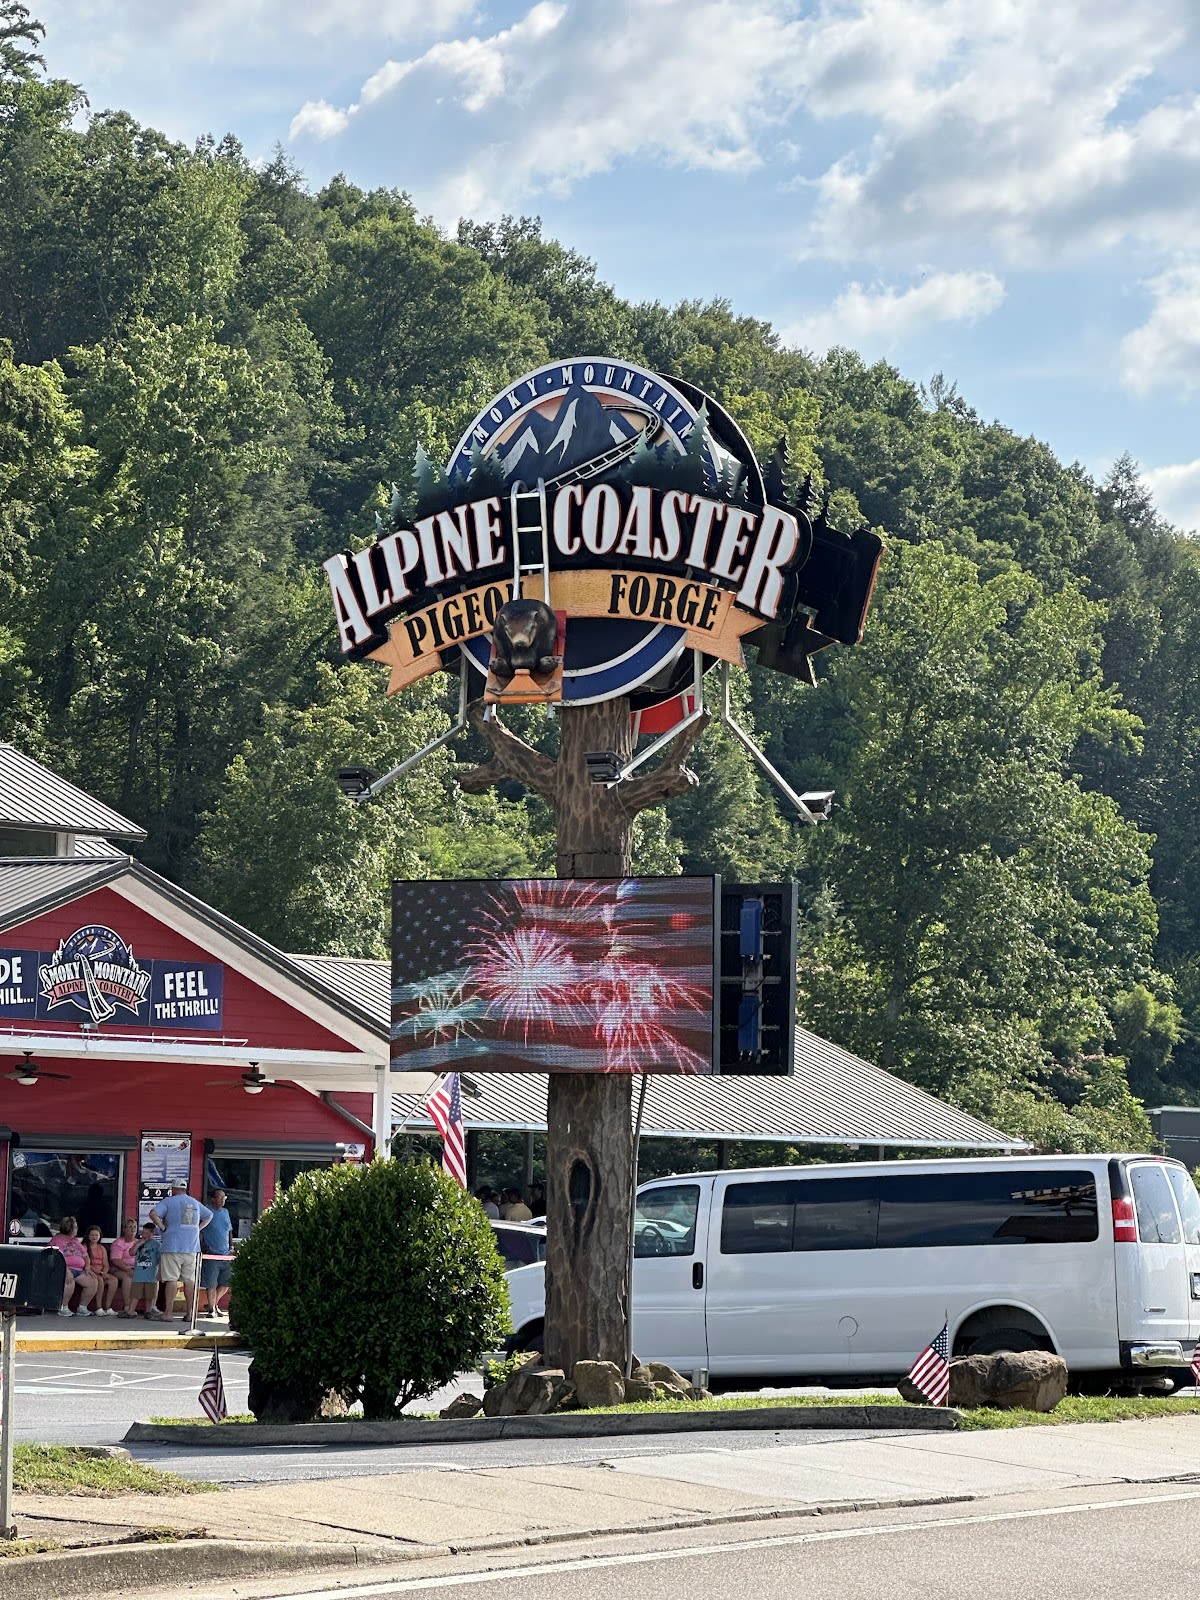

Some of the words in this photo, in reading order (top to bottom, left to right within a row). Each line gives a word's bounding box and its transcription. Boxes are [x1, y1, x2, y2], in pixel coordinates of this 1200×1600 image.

[562, 365, 696, 439] MOUNTAIN
[323, 497, 506, 653] ALPINE
[553, 483, 800, 619] COASTER
[608, 574, 721, 631] FORGE
[41, 962, 80, 989] SMOKY
[94, 961, 149, 996] MOUNTAIN
[58, 981, 84, 997] ALPINE
[99, 981, 132, 1000] COASTER
[164, 970, 208, 1000] FEEL
[154, 1001, 177, 1019] THE
[177, 998, 218, 1017] THRILL!
